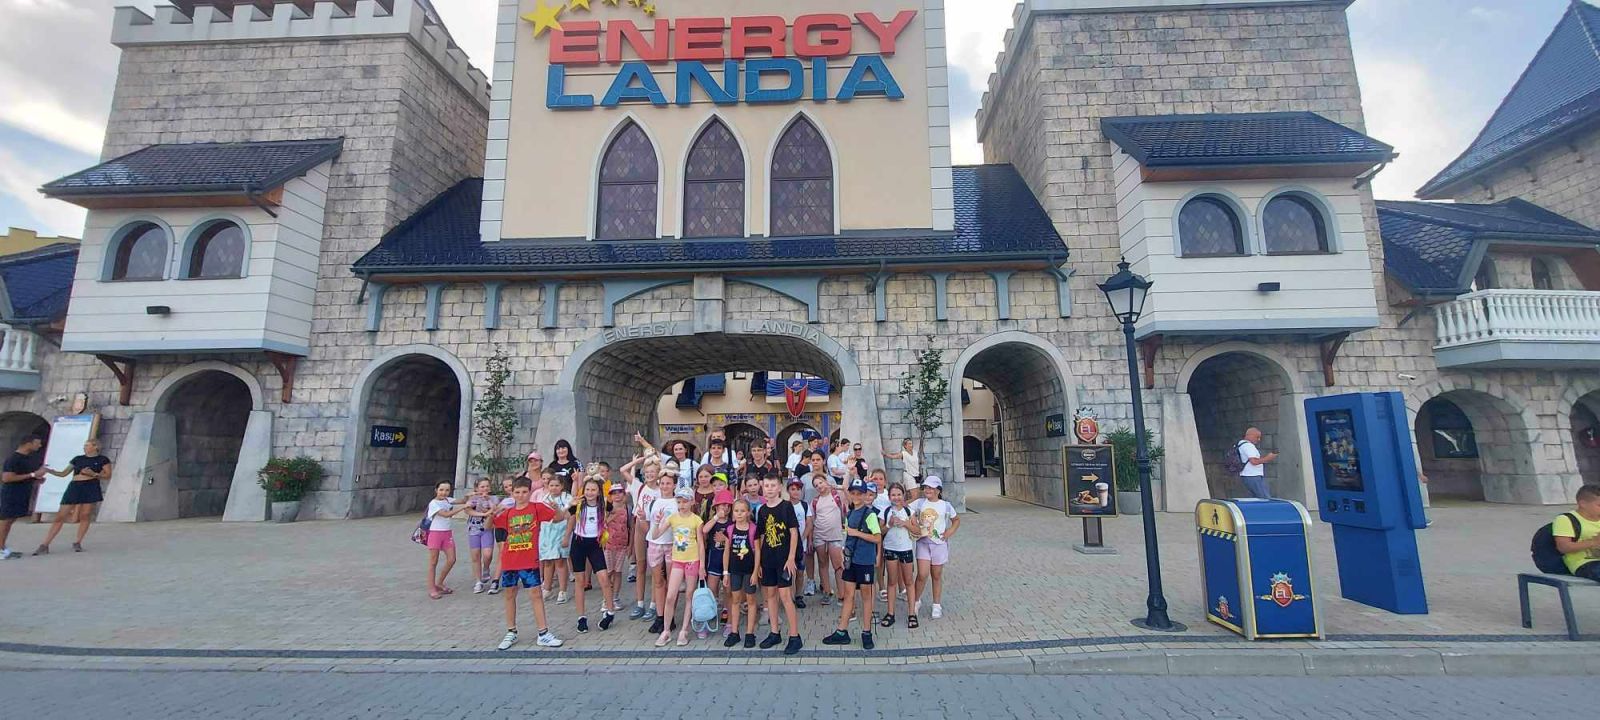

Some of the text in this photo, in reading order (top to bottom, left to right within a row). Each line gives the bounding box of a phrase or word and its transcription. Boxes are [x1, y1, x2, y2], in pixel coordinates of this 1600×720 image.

[548, 10, 918, 64] ENERGY
[546, 55, 905, 109] LANDIA
[602, 320, 821, 345] ENERGY LANDIA
[1080, 425, 1096, 434] EL
[1275, 589, 1291, 599] EL
